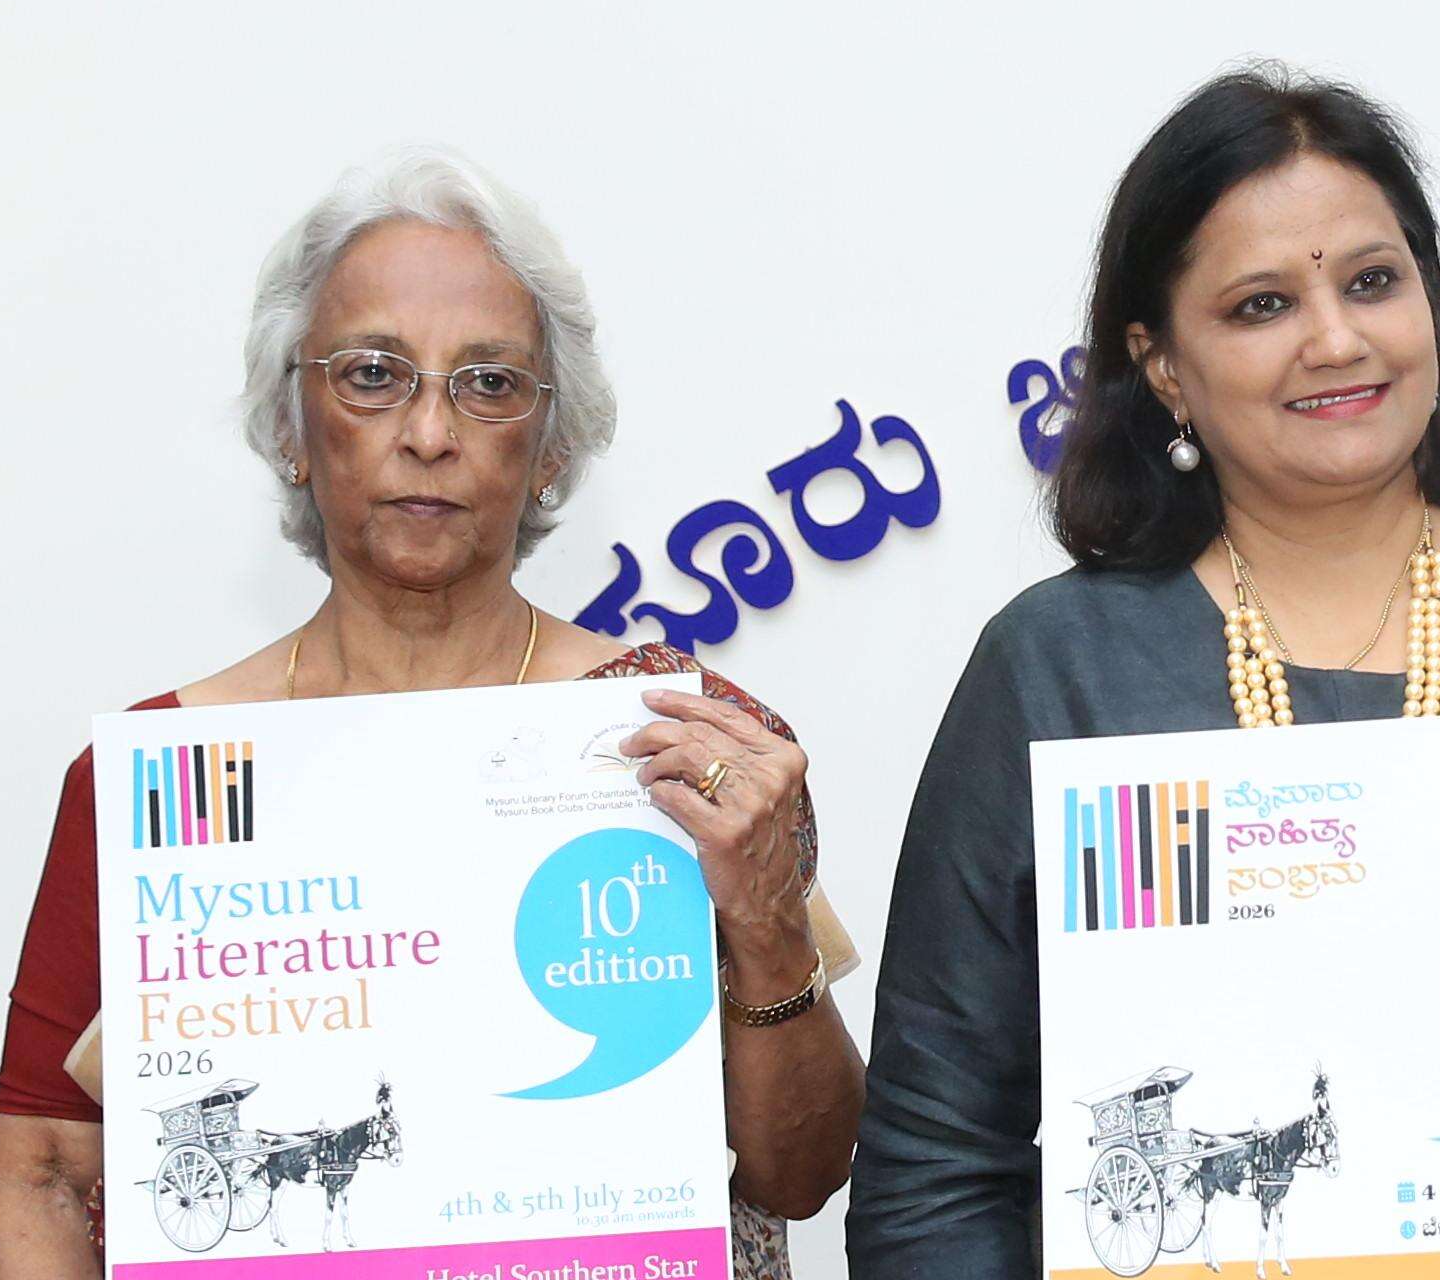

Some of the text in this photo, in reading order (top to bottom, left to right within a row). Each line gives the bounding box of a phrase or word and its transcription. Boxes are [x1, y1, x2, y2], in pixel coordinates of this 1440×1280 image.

[1224, 781, 1362, 818] ಮೈಸೂರು
[1226, 818, 1356, 858] ಸಾಹಿತ್ಯ
[577, 855, 668, 939] 10th
[1227, 861, 1366, 899] ಸಂಭ್ರಮ
[135, 873, 362, 935] Mysuru
[1228, 903, 1275, 920] 2026
[137, 927, 440, 983] Literature
[545, 947, 693, 988] edition
[138, 978, 372, 1042] Festival
[137, 1049, 213, 1077] 2026
[439, 1178, 695, 1222] 4th & 5th July 2026
[1422, 1184, 1436, 1201] 4
[644, 1255, 698, 1279] Star
